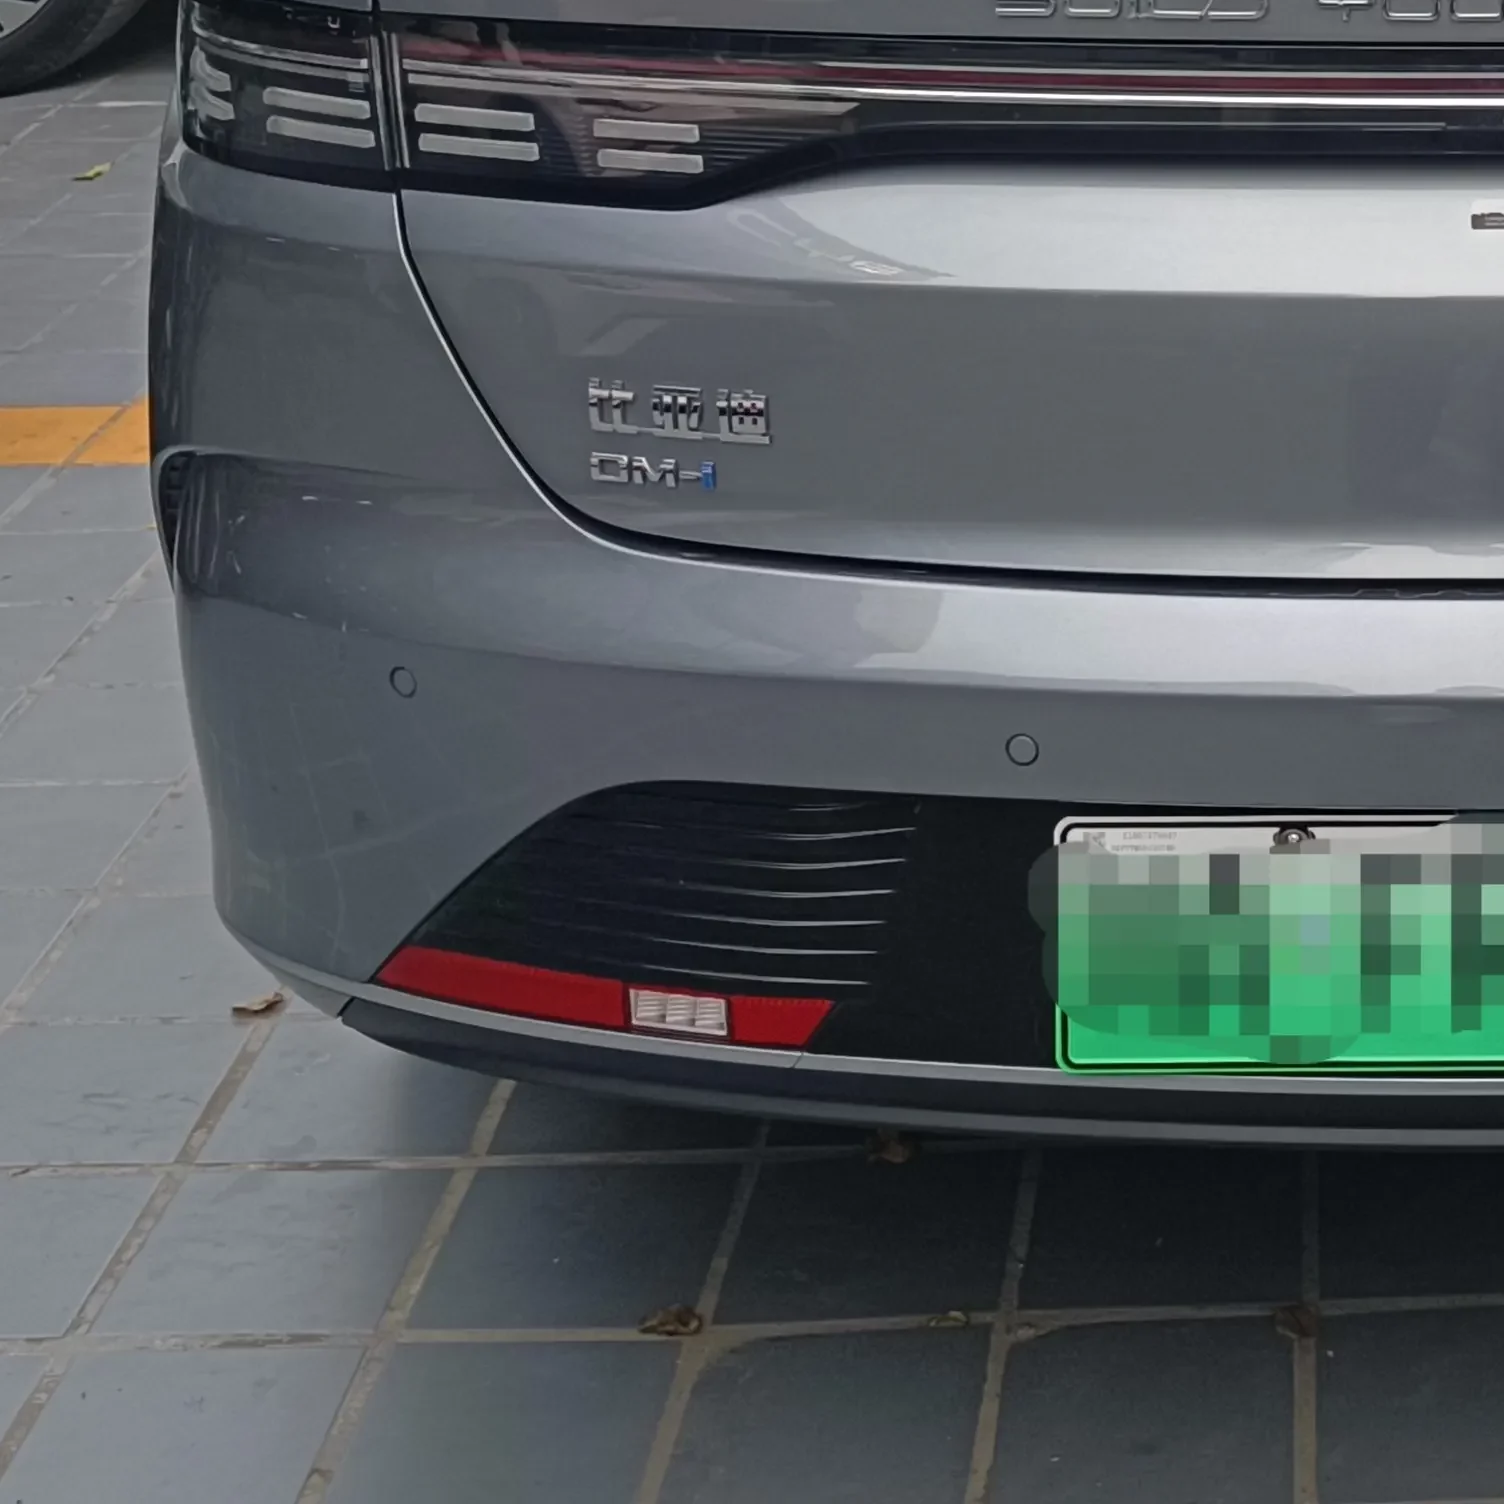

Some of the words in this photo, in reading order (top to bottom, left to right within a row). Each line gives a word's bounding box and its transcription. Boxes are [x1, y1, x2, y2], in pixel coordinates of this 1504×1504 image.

[588, 377, 773, 444] 比亚迪
[590, 451, 717, 490] DM-i
